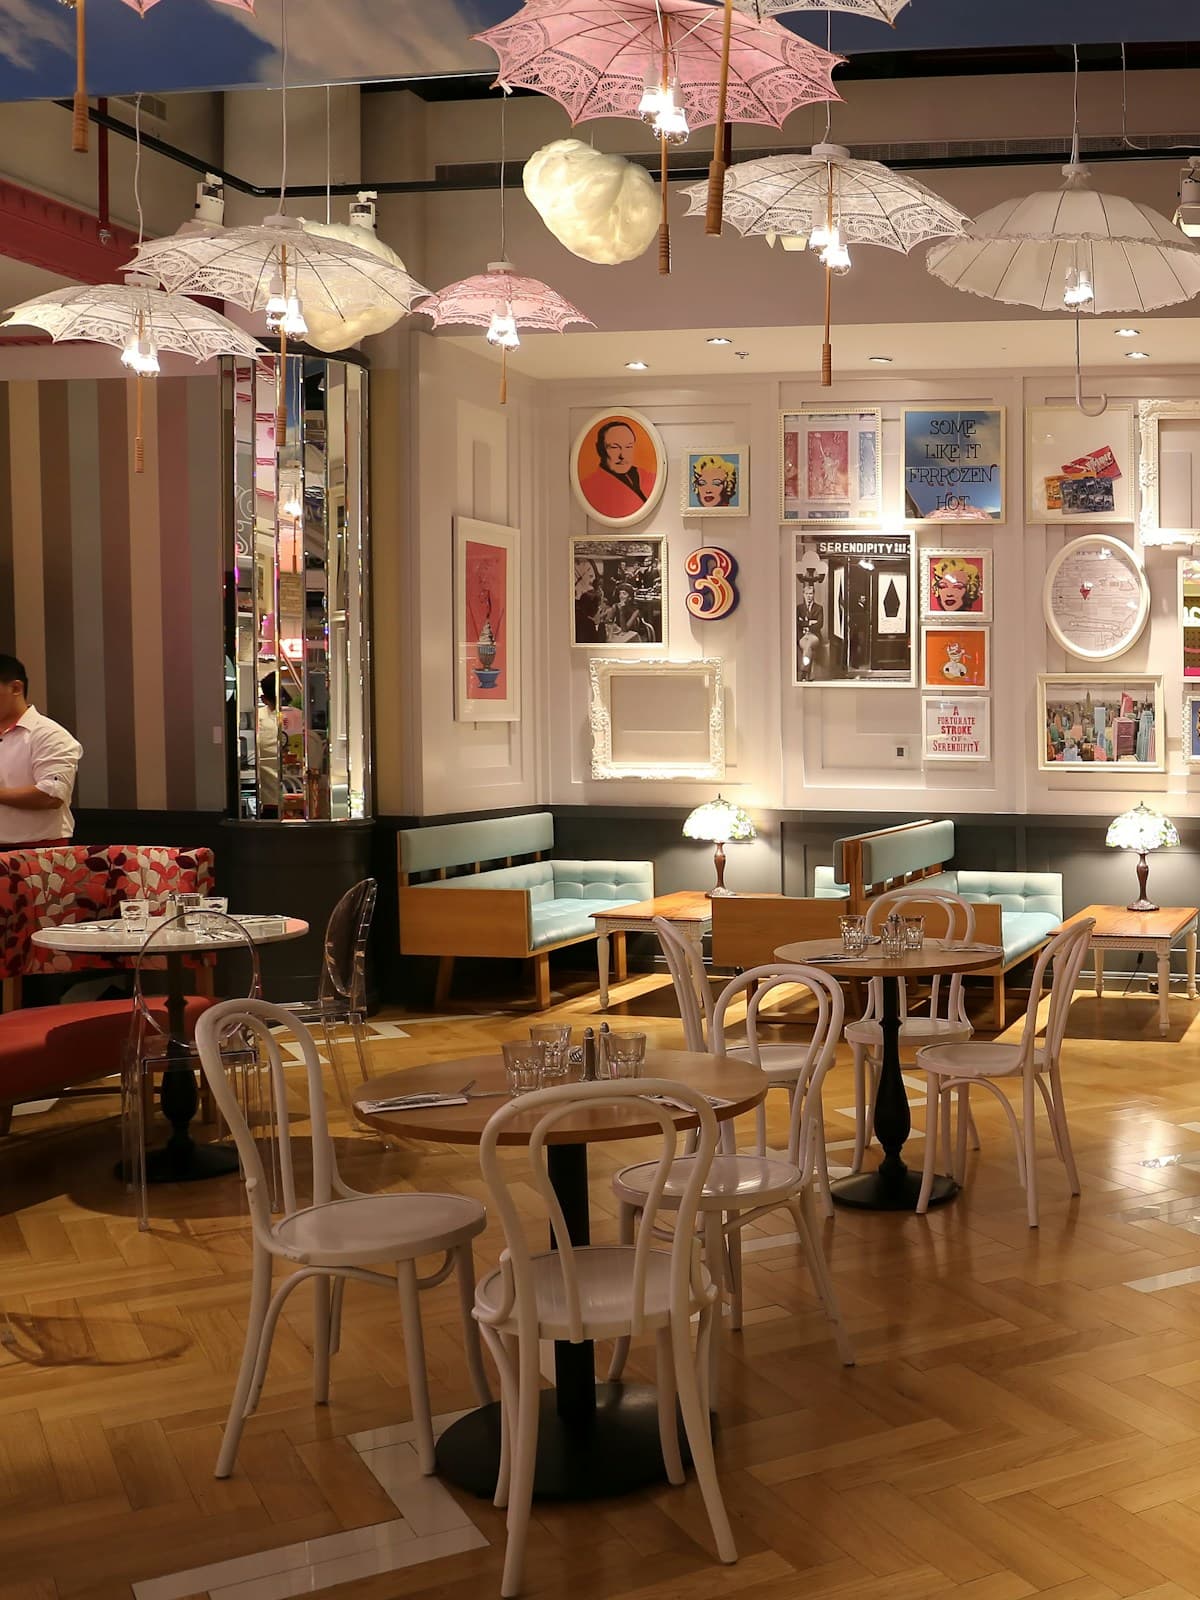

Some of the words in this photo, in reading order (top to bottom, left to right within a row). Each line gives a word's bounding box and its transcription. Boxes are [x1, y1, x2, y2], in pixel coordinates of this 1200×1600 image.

[929, 419, 977, 438] SOME
[925, 443, 961, 463] LIKE
[966, 443, 982, 459] IT
[909, 464, 998, 487] FRRROZEN
[935, 492, 970, 511] HOT
[820, 542, 893, 554] SERENDIPITY
[684, 546, 740, 621] 3
[953, 705, 959, 716] A
[937, 716, 976, 725] FORTUNATE
[941, 726, 972, 735] STROKE
